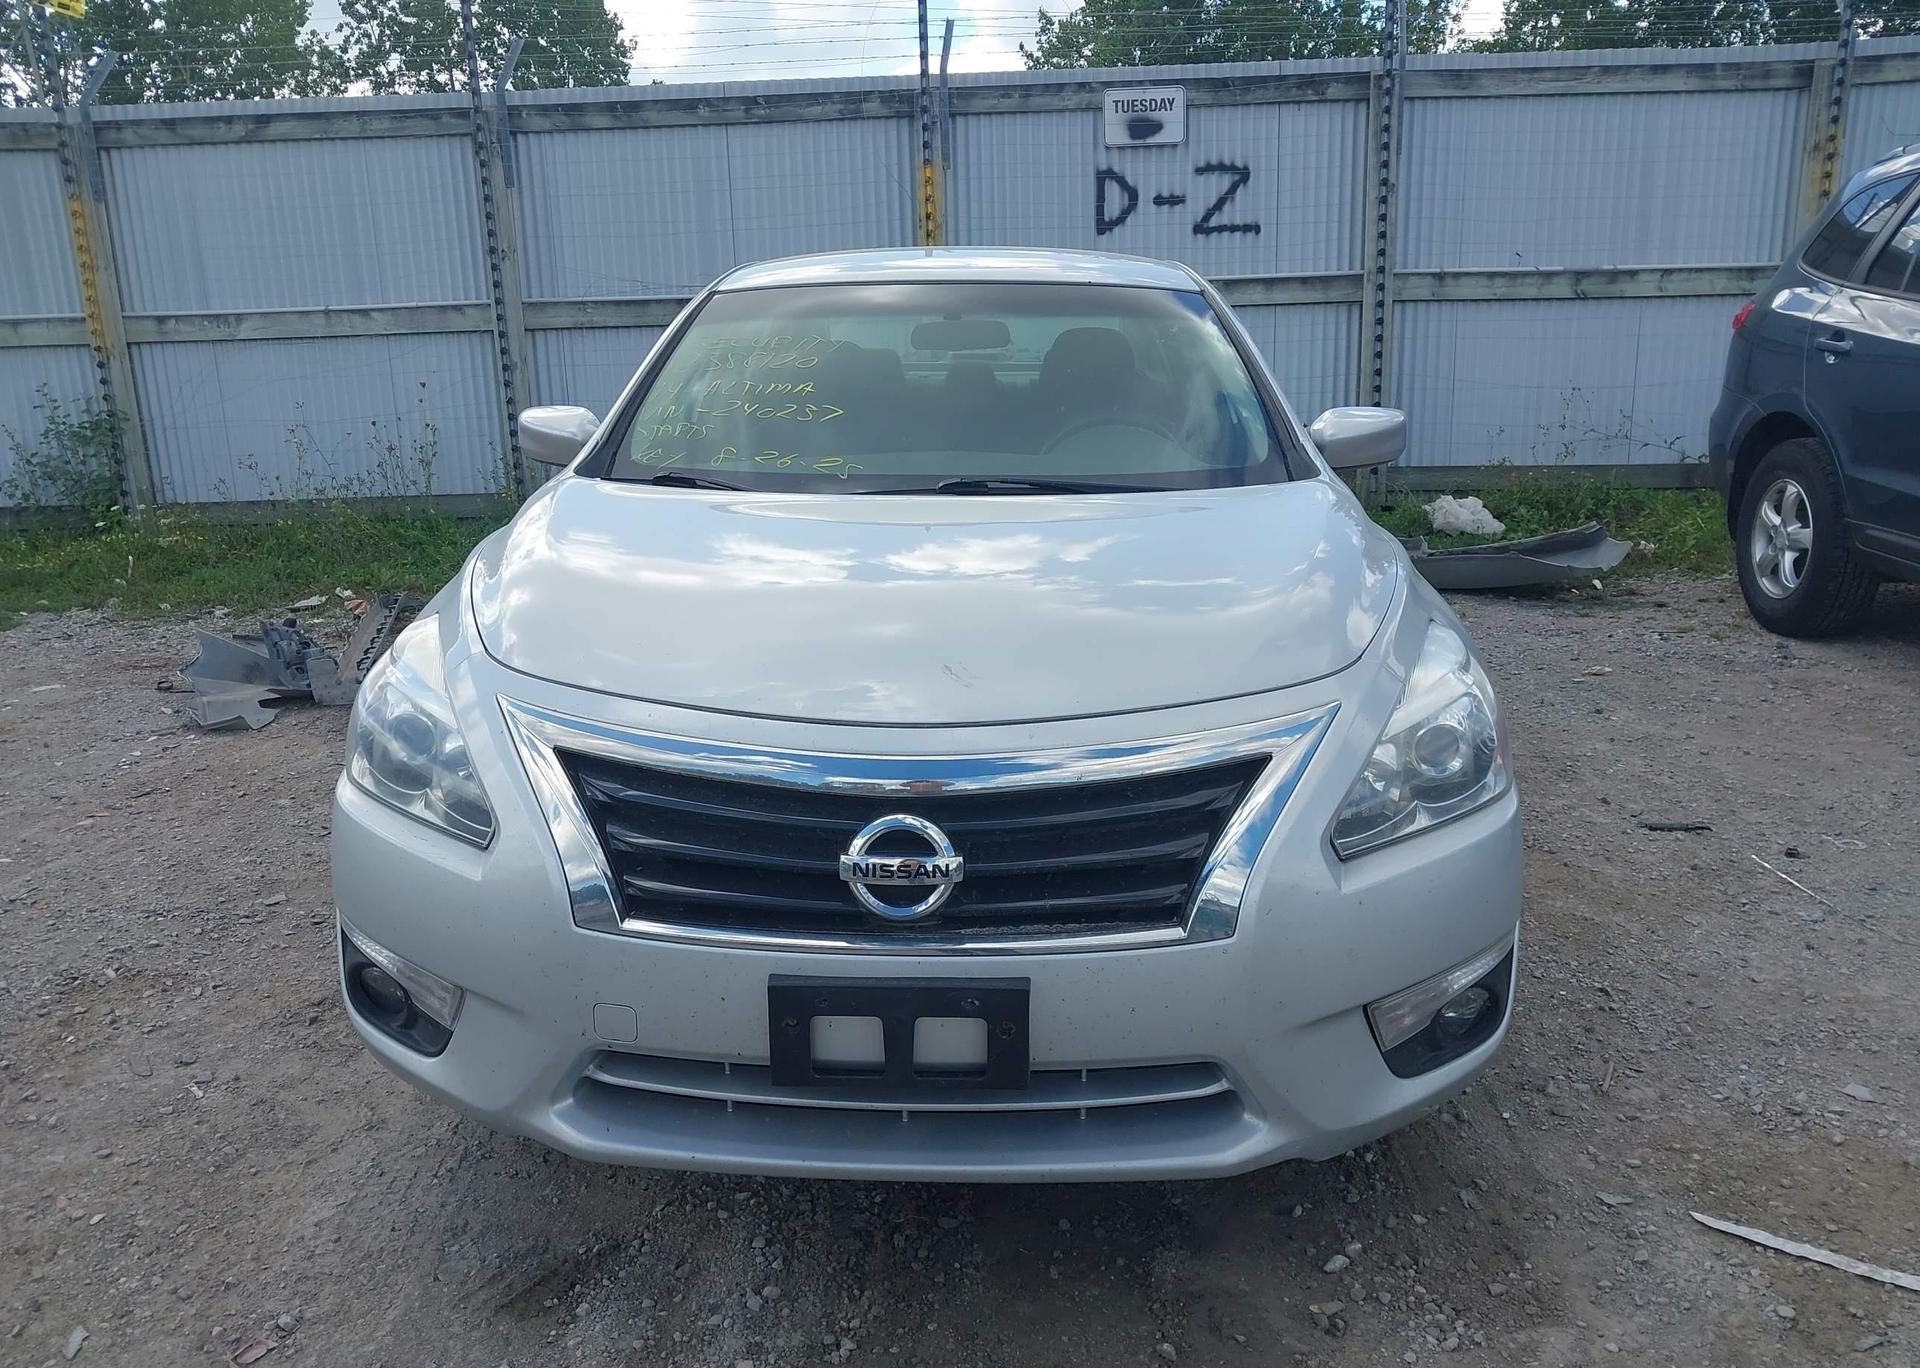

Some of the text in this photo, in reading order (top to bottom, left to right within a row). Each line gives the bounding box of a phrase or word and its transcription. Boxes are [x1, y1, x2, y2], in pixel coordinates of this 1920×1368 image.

[1112, 97, 1176, 114] TUESDAY
[703, 378, 815, 397] ALTIMA
[852, 862, 950, 879] NISSAN
